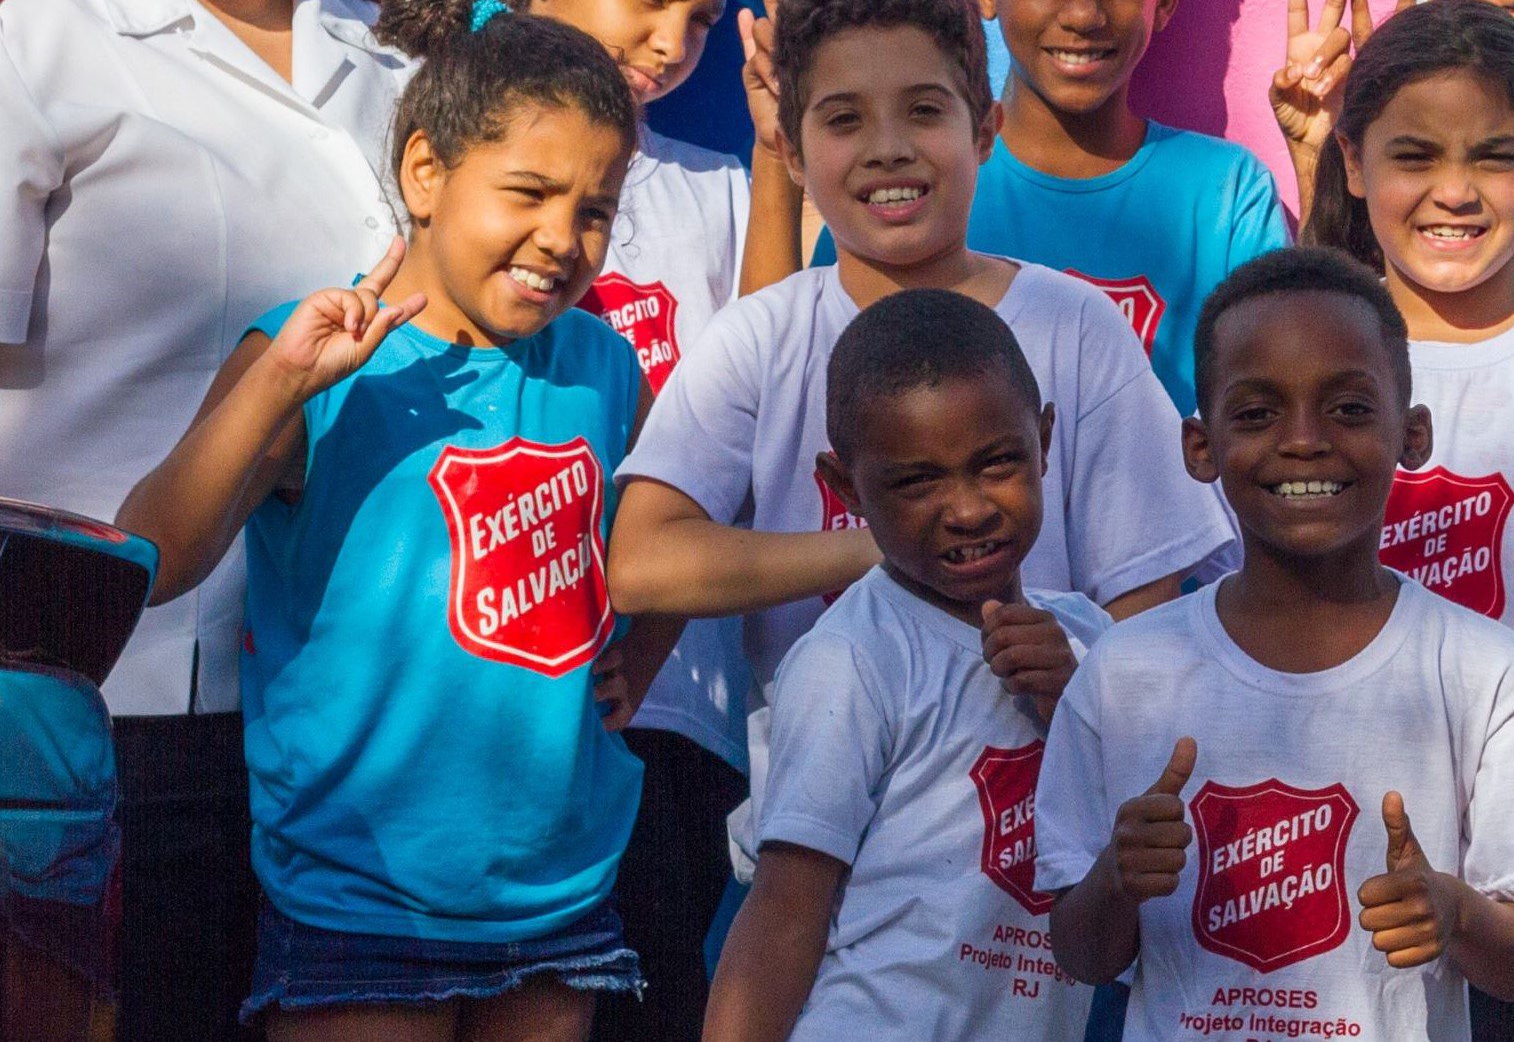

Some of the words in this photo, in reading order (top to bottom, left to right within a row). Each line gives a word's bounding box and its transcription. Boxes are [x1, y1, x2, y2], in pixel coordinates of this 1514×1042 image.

[602, 296, 660, 330] RCITO
[469, 460, 589, 561] EXÉRCITO
[1379, 491, 1492, 549] EXÉRCITO
[531, 522, 557, 558] DE
[1424, 533, 1447, 558] DE
[1404, 546, 1490, 588] VAÇÃO
[1212, 803, 1332, 875] EXÉRCITO
[1260, 851, 1285, 878] DE
[1208, 863, 1333, 932] SALVAÇÃO
[993, 924, 1053, 950] APROS
[960, 943, 1012, 969] Projeto
[1013, 978, 1040, 998] RJ
[1212, 988, 1318, 1008] APROSES
[1250, 1013, 1361, 1038] Integração
